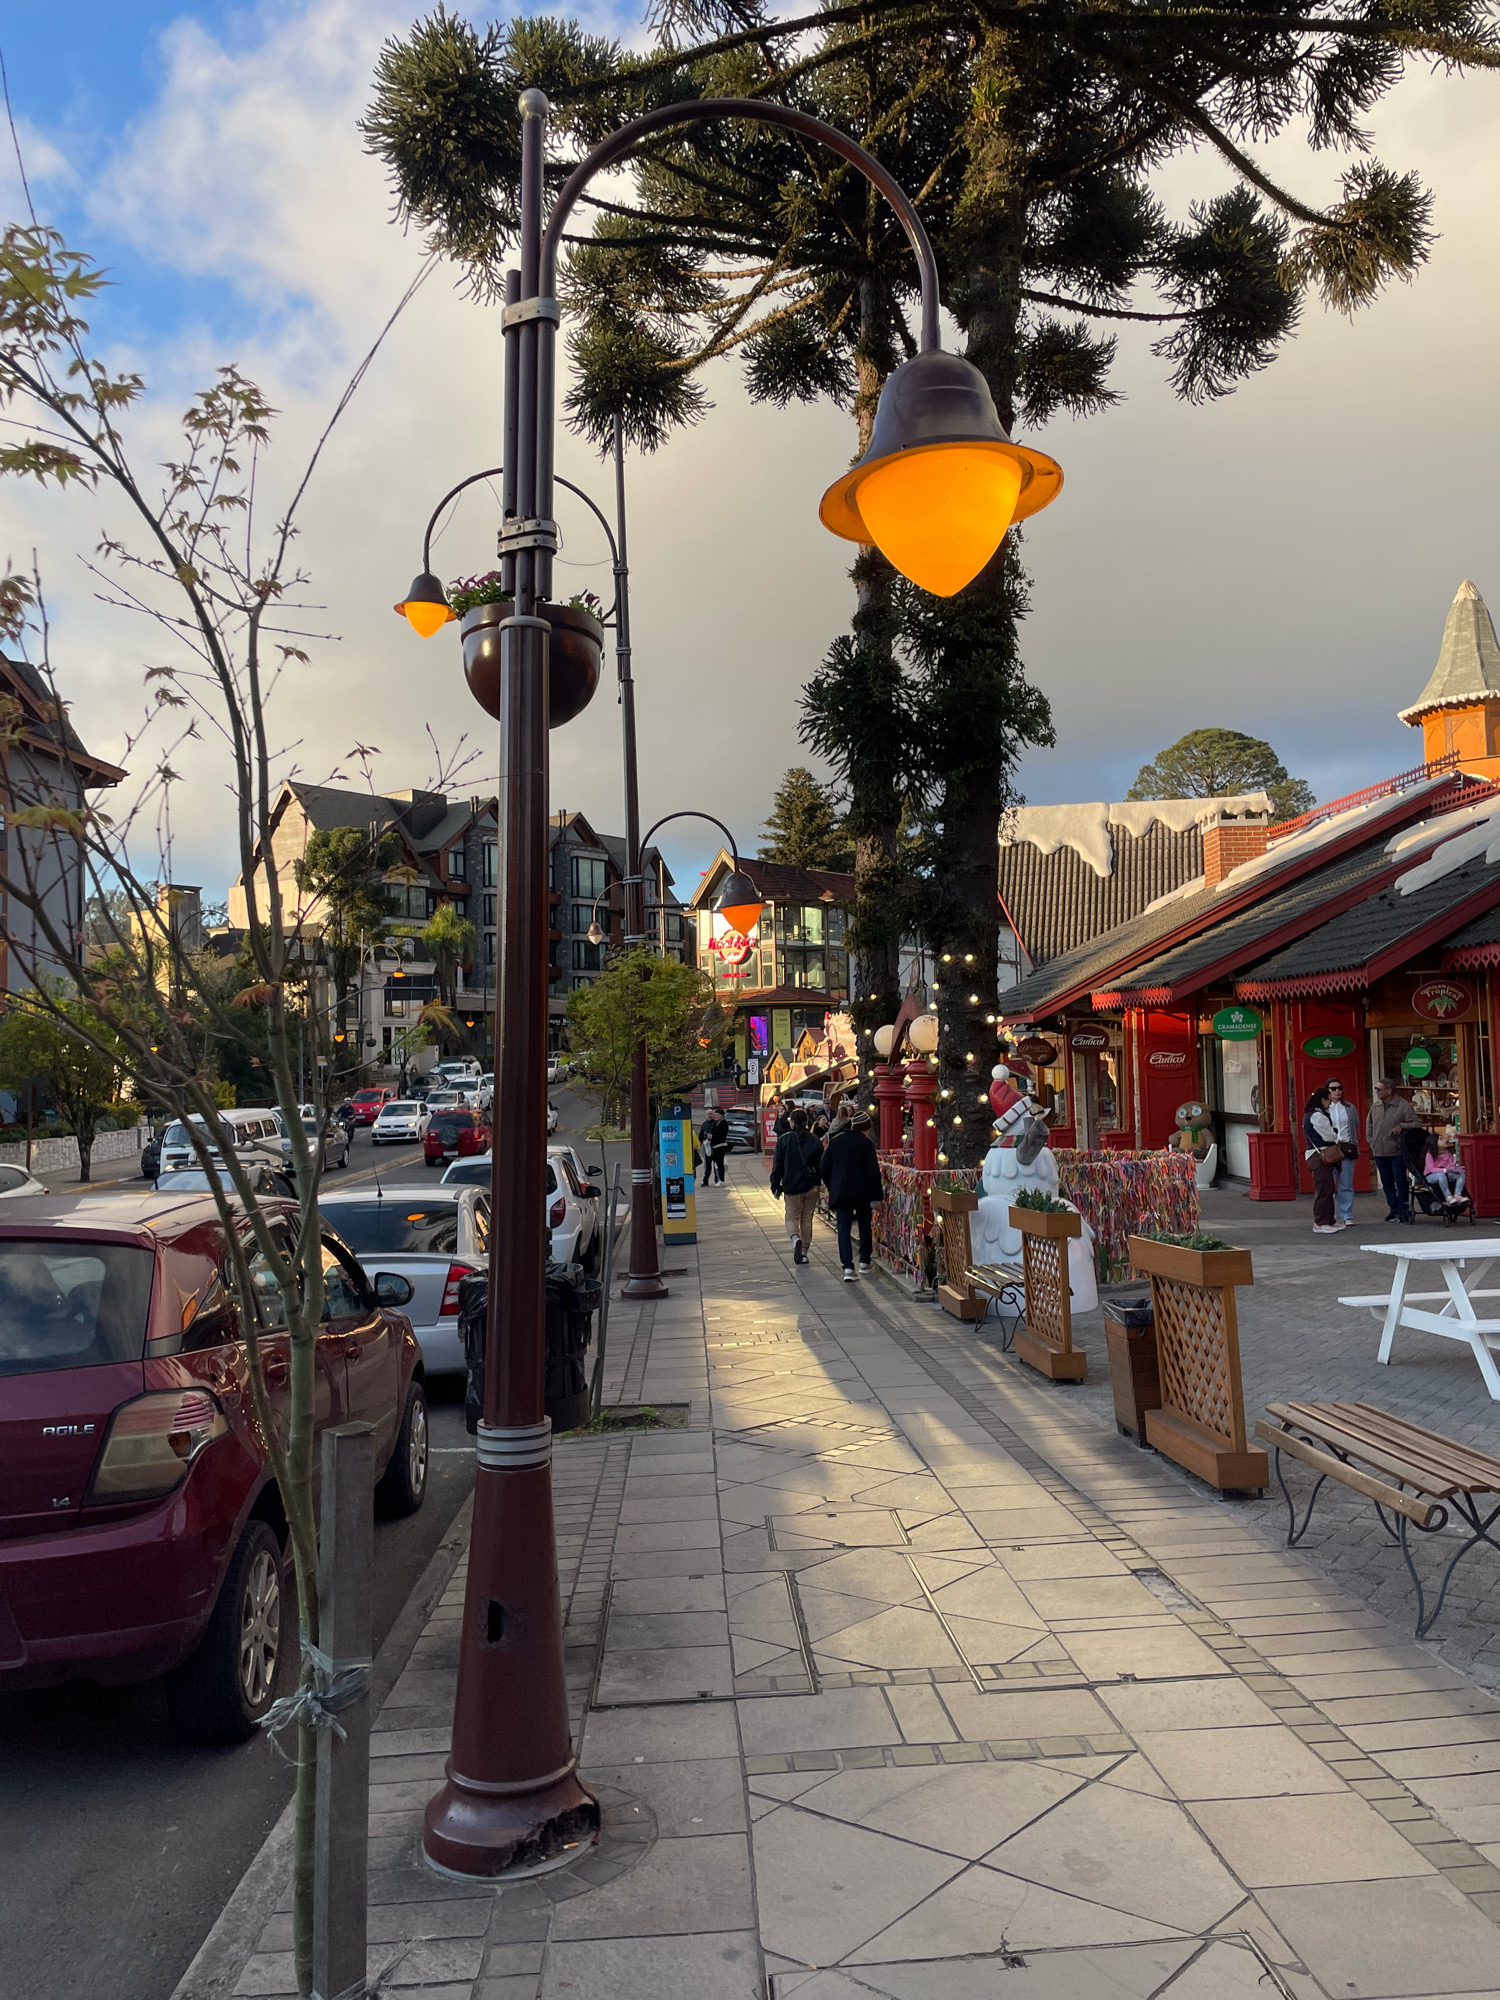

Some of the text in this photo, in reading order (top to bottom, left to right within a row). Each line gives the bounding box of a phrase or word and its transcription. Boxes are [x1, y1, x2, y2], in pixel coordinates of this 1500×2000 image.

[1426, 987, 1460, 1000] Tropical
[1072, 1034, 1105, 1046] Caracol
[1149, 1051, 1186, 1065] Caracol
[673, 1106, 681, 1116] P
[42, 1424, 95, 1436] AGILE
